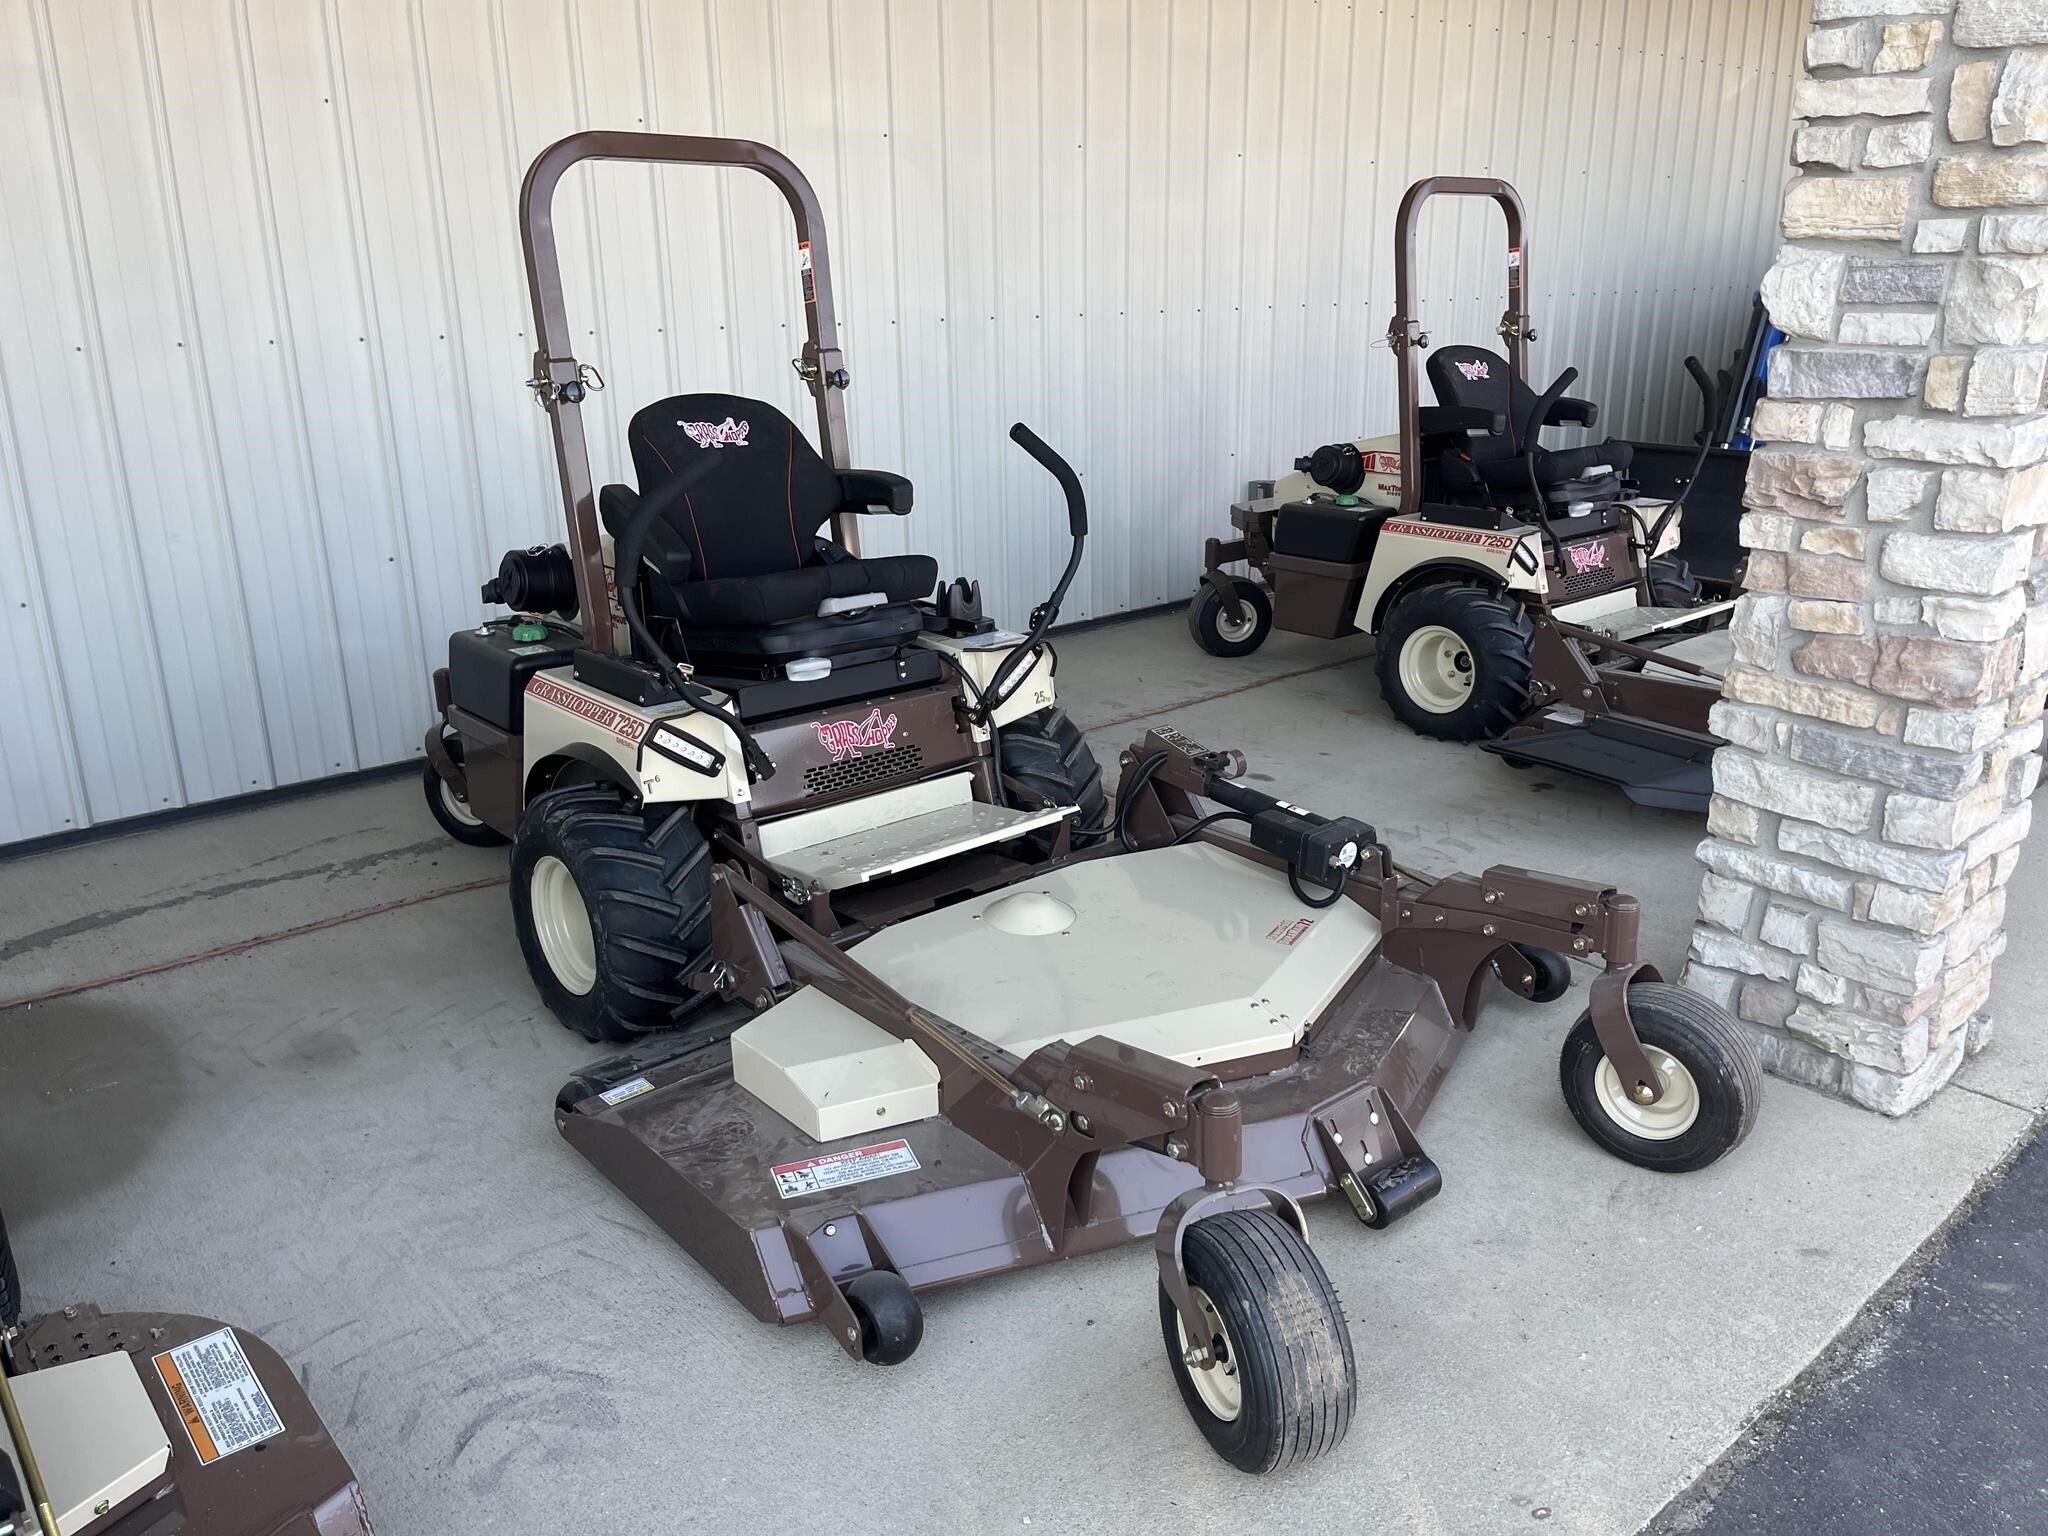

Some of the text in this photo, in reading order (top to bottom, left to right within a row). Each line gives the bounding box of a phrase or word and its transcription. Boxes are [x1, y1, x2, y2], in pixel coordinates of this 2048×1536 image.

[1388, 523, 1513, 549] GRASSHOPPER 725D
[532, 680, 613, 728] GRASSHOPPER
[613, 713, 645, 740] 725D
[818, 1150, 864, 1165] DANGER
[171, 1382, 195, 1417] WARNING
